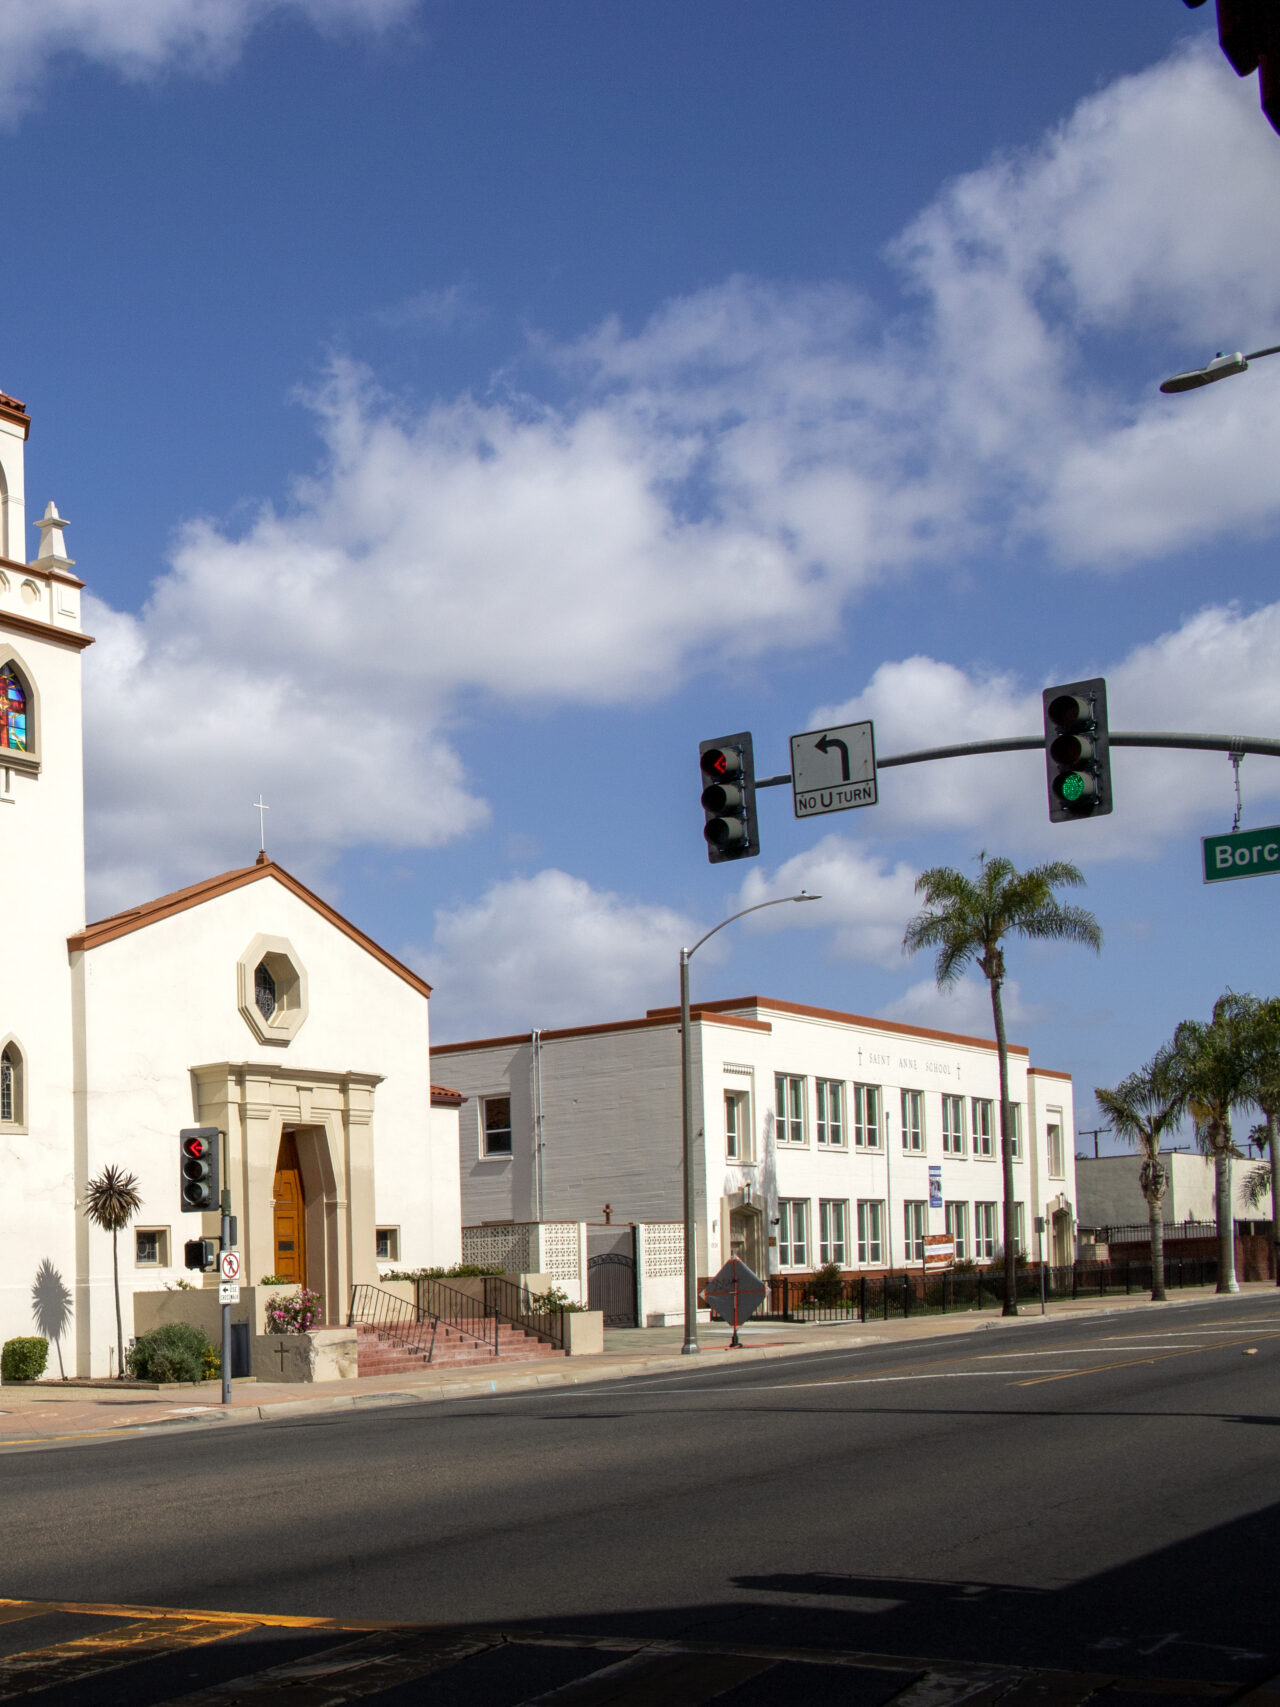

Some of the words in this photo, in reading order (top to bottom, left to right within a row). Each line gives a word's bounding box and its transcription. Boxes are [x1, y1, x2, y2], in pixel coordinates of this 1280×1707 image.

[799, 797, 817, 810] NO
[821, 791, 833, 808] U
[836, 787, 872, 804] TURN
[1215, 843, 1280, 869] Borc
[869, 1052, 890, 1066] SAINT
[899, 1058, 918, 1071] ANNE
[925, 1062, 951, 1075] SCHOOL
